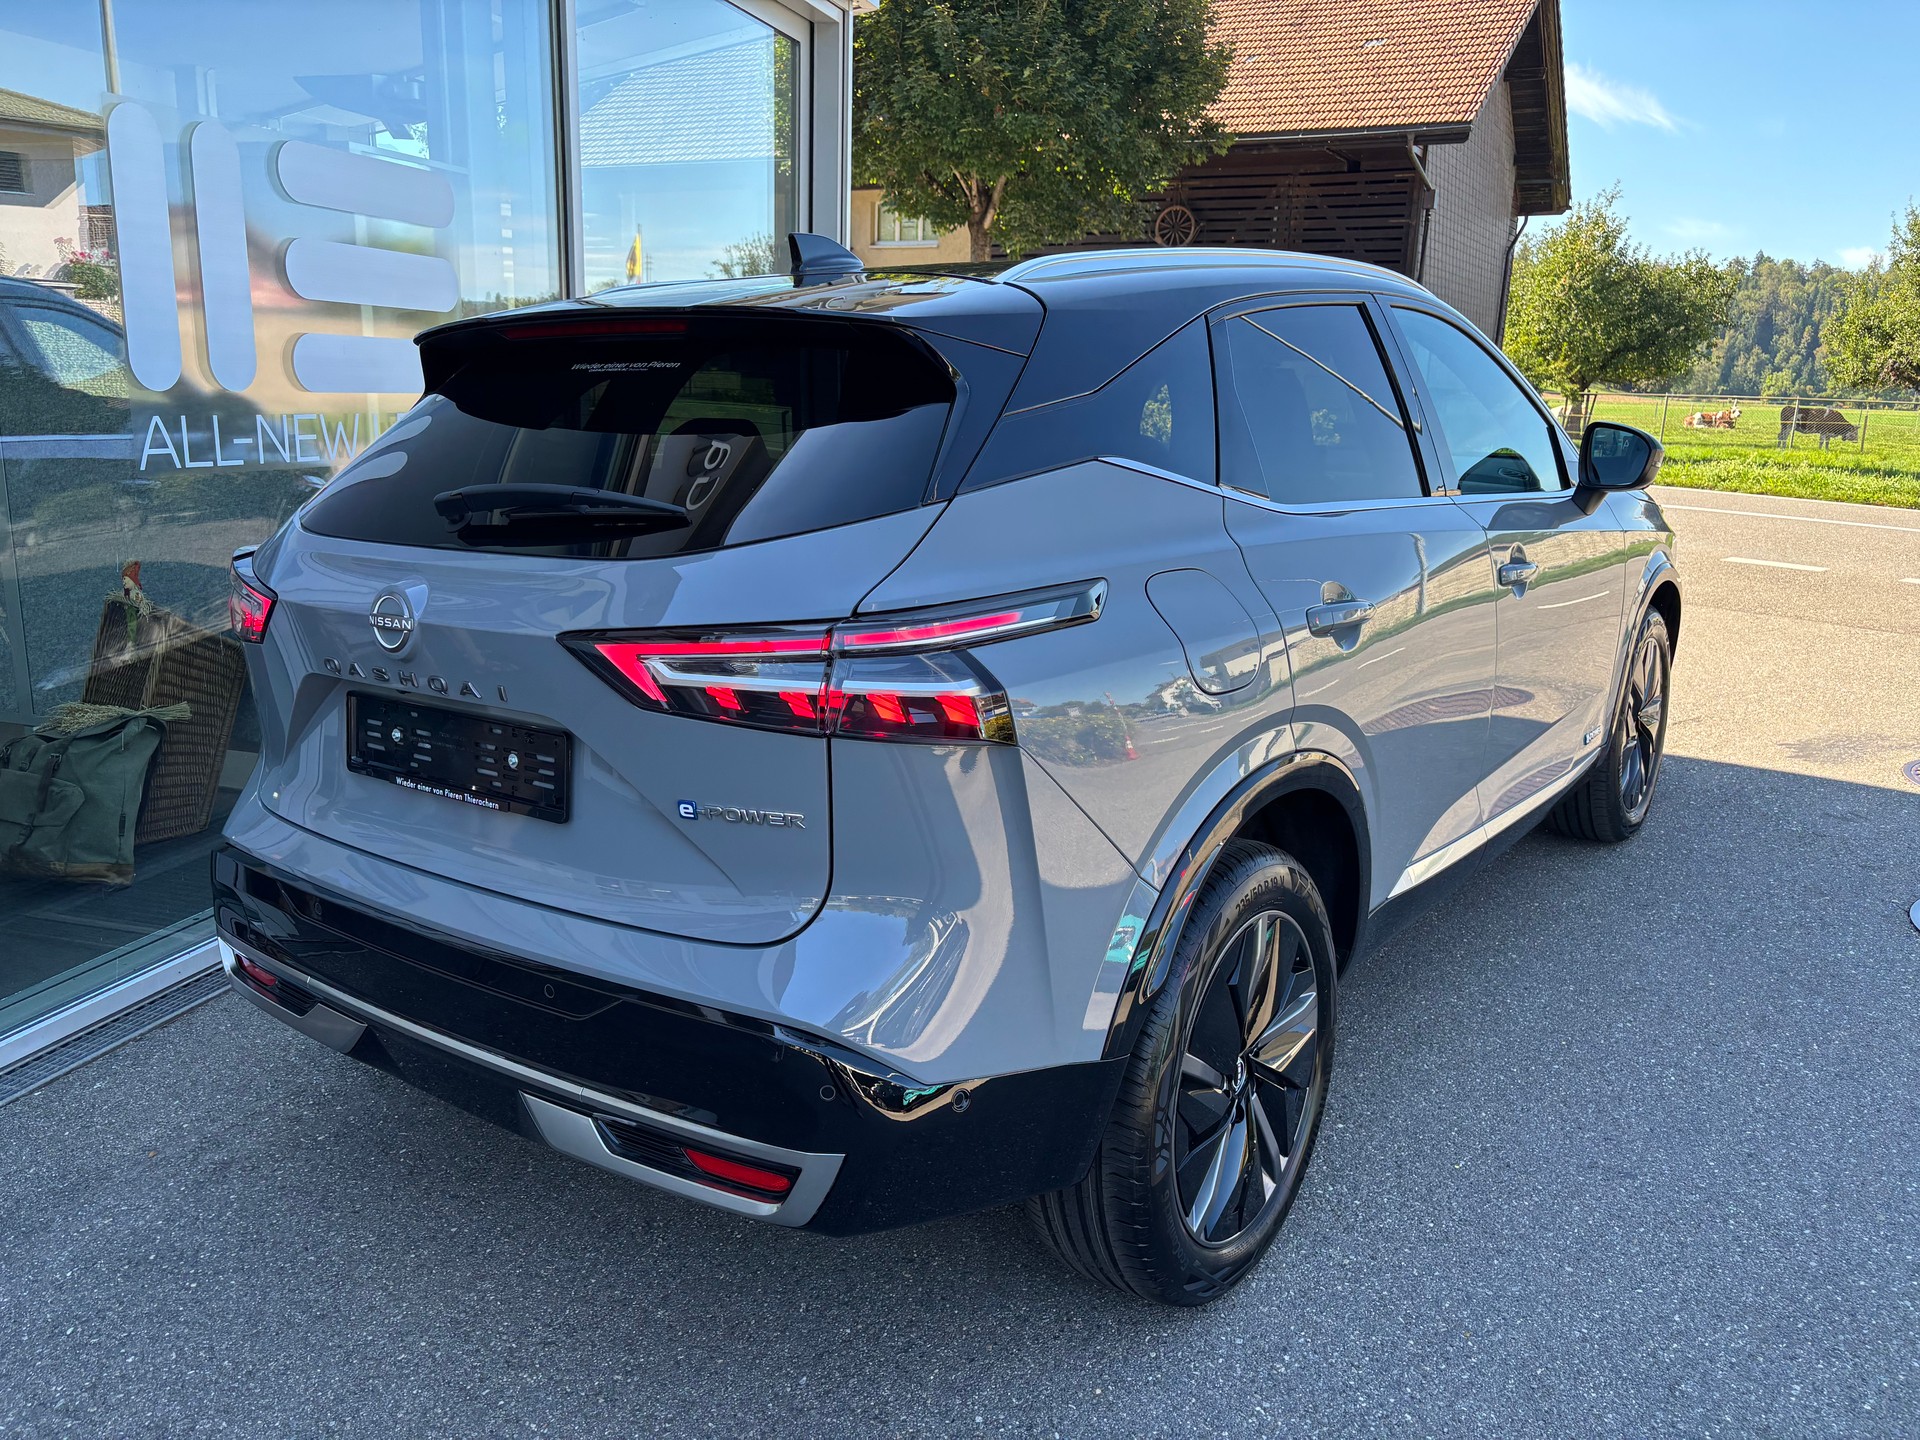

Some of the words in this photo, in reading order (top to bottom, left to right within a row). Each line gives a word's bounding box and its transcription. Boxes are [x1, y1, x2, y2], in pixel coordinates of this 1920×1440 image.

[604, 361, 629, 369] einer
[629, 361, 648, 369] von
[647, 360, 681, 369] Pieren
[140, 413, 359, 471] ALL-NEW
[369, 614, 412, 630] NISSAN
[323, 656, 509, 703] QASHQAI
[395, 776, 416, 789] Wieder
[417, 782, 432, 793] einer
[432, 787, 444, 796] von
[444, 788, 463, 801] Pieren
[464, 793, 500, 810] Thierachern
[678, 802, 806, 829] e-POWER
